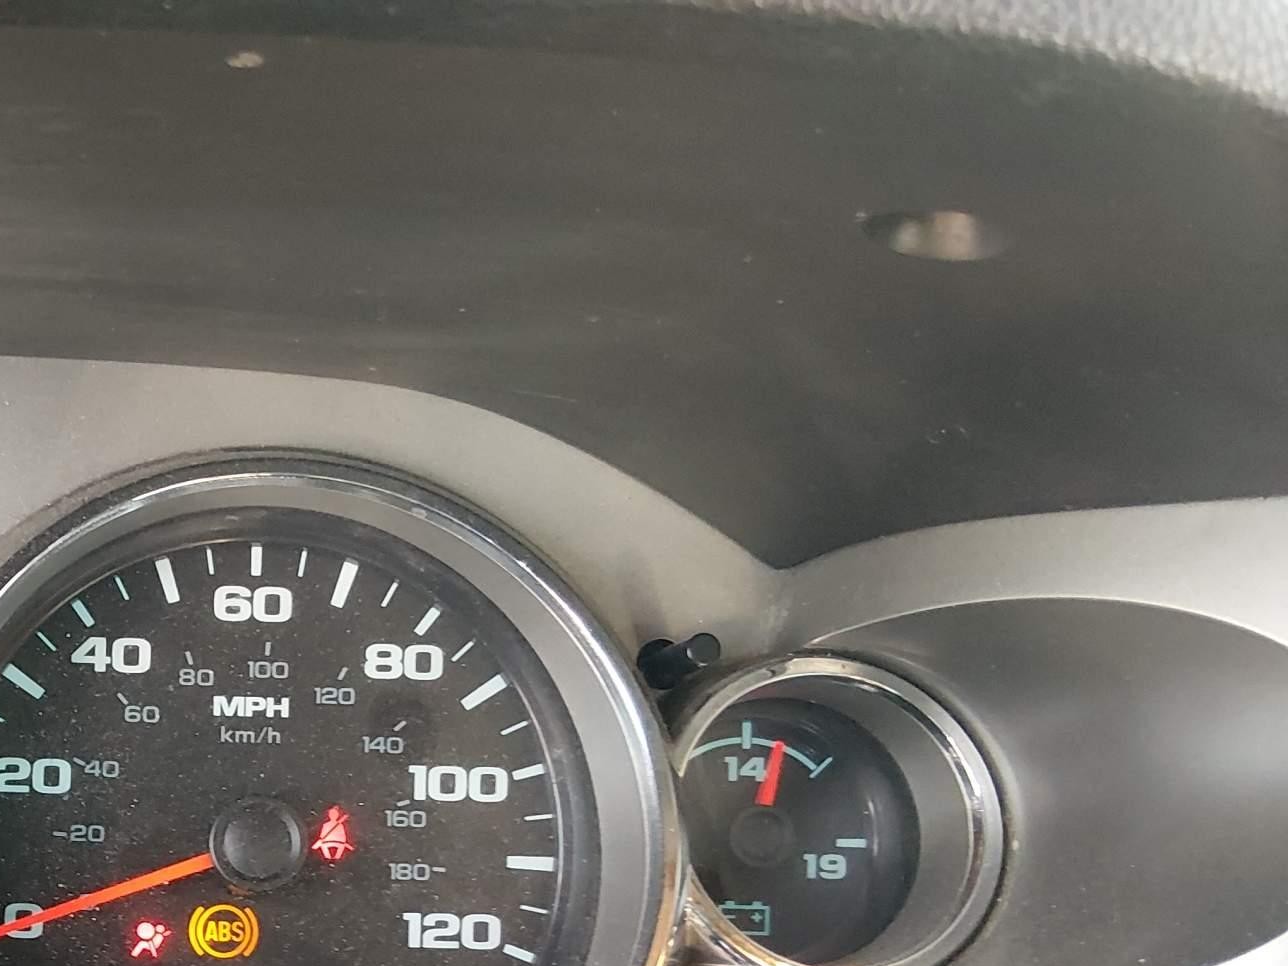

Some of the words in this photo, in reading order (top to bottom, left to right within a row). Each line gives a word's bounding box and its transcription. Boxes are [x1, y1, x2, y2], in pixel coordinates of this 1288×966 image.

[213, 586, 292, 622] 60
[71, 637, 152, 674] 40
[364, 644, 444, 681] 80
[178, 668, 214, 687] 80
[247, 660, 289, 680] 100
[213, 695, 290, 719] MPH
[314, 687, 356, 707] 120
[124, 704, 160, 724] 60
[220, 725, 281, 745] km/h
[362, 737, 405, 755] 140
[83, 761, 120, 779] 40
[724, 756, 767, 782] 14
[408, 765, 509, 802] 100
[385, 810, 427, 829] 160
[67, 824, 106, 843] 20
[390, 863, 431, 882] 180
[803, 854, 847, 880] 19
[4, 903, 44, 940] 0
[205, 920, 246, 944] ABS
[403, 912, 502, 950] 120
